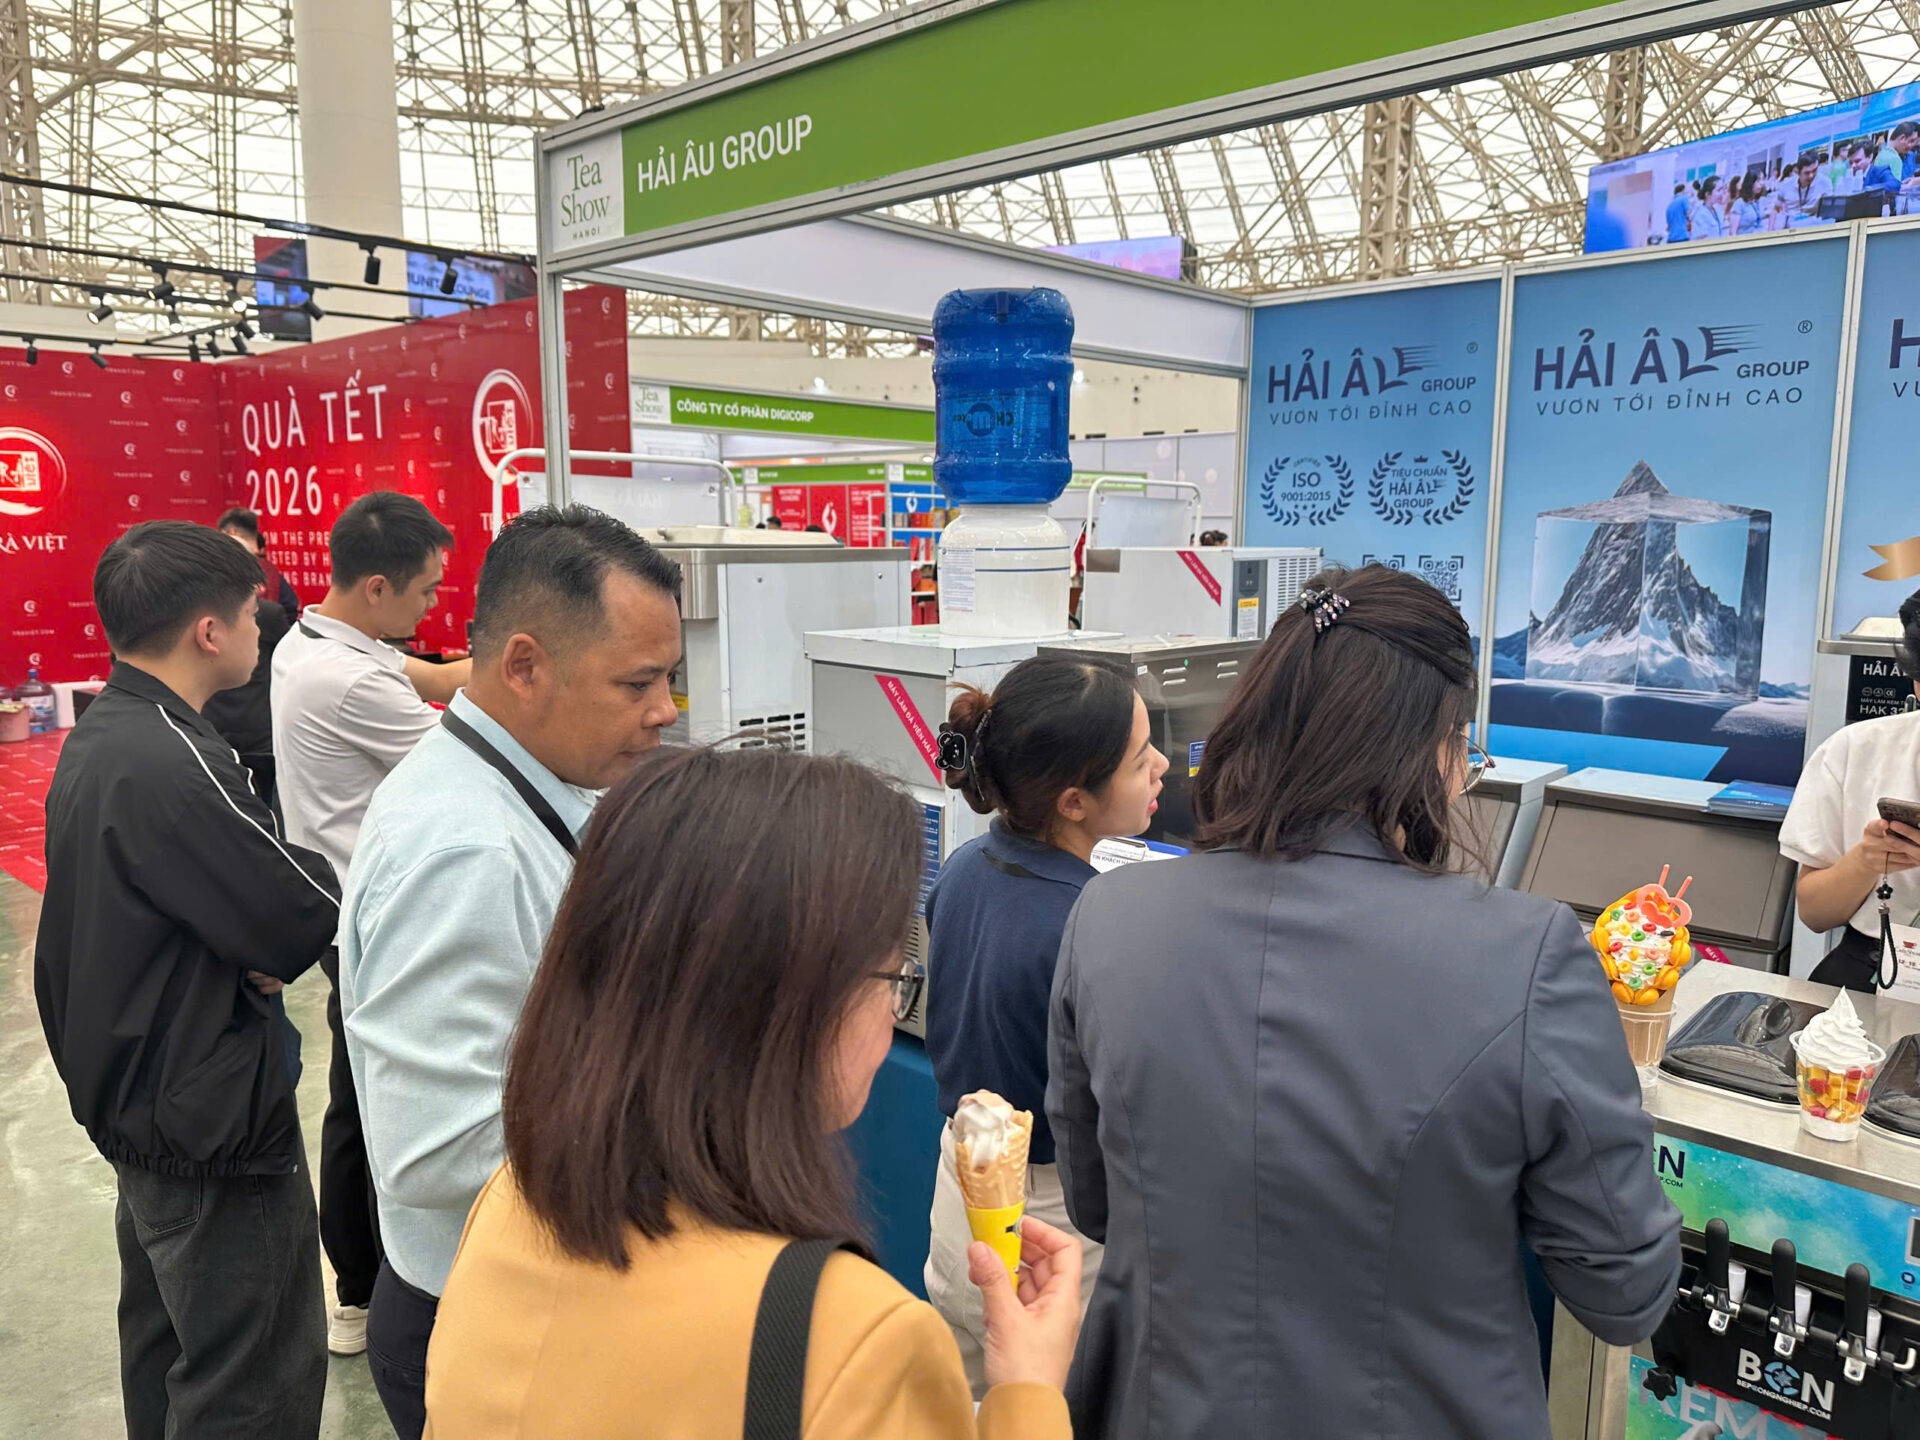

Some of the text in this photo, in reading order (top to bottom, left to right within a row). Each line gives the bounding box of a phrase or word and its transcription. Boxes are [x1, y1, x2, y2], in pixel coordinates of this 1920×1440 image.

[638, 114, 812, 193] HẢI ÂU GROUP
[567, 153, 602, 191] Tea
[560, 193, 610, 228] Show
[572, 226, 601, 240] HANOI
[1534, 328, 1615, 391] HẢI
[1268, 348, 1330, 403] HẢI
[1736, 360, 1810, 379] GROUP
[1421, 376, 1477, 392] GROUP
[1614, 392, 1652, 412] TỚI
[1667, 388, 1730, 409] ĐỈNH
[1746, 387, 1802, 406] CAO
[242, 369, 387, 457] QUÀ TẾT
[676, 398, 707, 414] CÔNG
[709, 402, 722, 415] TY
[770, 410, 815, 422] DIGICORP
[1328, 403, 1359, 422] TỚI
[1369, 400, 1417, 419] ĐỈNH
[1428, 399, 1472, 416] CAO
[1292, 472, 1321, 488] ISO
[1392, 467, 1412, 478] TIÊU
[246, 465, 322, 517] 2026
[1281, 490, 1331, 502] 9001:2015
[1389, 478, 1412, 496] HẢI
[1393, 498, 1434, 509] GROUP
[22, 531, 67, 554] VIỆT
[282, 531, 304, 546] THE
[308, 531, 330, 546] PRE
[303, 551, 316, 567] BY
[303, 571, 332, 587] BRAN
[1863, 660, 1887, 676] HẢI
[1860, 704, 1887, 716] HAK
